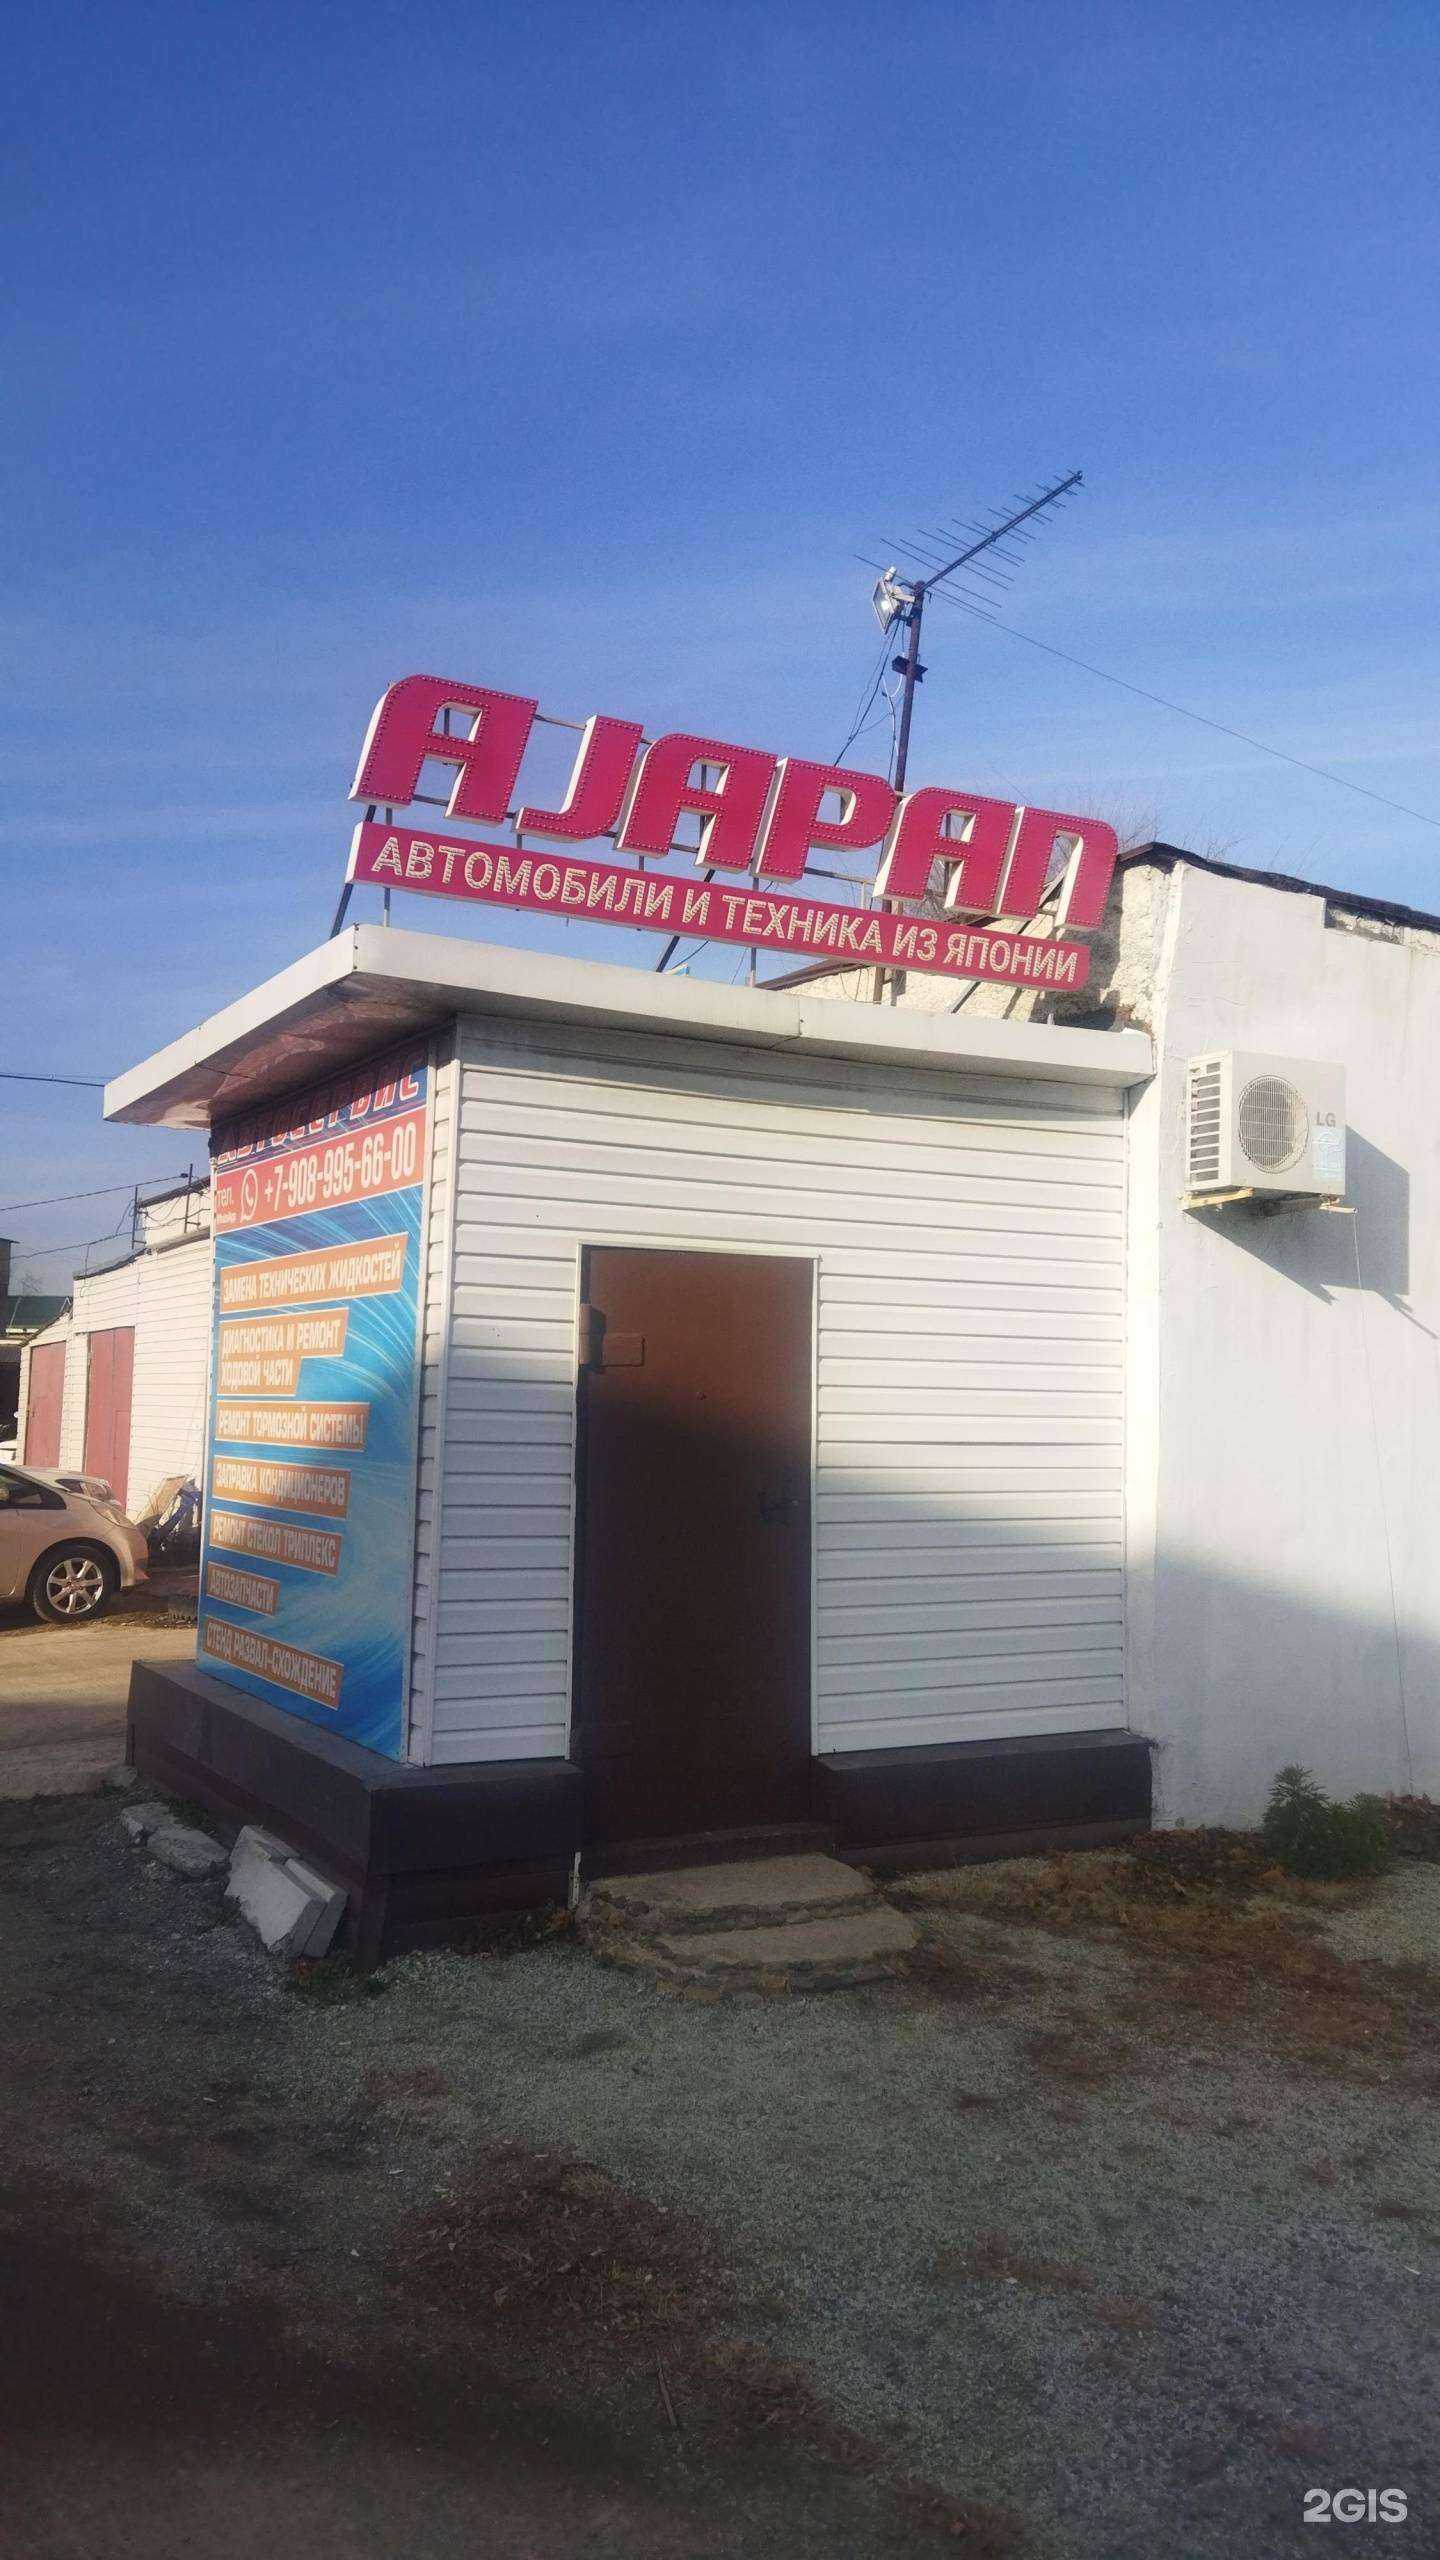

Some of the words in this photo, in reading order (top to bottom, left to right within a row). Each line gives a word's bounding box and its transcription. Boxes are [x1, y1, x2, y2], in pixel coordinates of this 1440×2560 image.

[371, 836, 674, 920] АВТОМОБИЛИ
[682, 888, 711, 926] И
[722, 894, 882, 954] ТЕХНИКА
[892, 923, 938, 961] ИЗ
[943, 932, 1079, 983] ЯПОНИИ
[1316, 1111, 1337, 1128] LG
[264, 1121, 417, 1212] +7-908-995-66-00
[223, 1274, 257, 1304] ЗАМЕНА
[259, 1261, 326, 1299] ТЕХНИЧЕСКИХ
[329, 1241, 401, 1292] ЖИДКОСТЕЙ
[222, 1326, 283, 1359] ДИАГНОСТИКА
[297, 1319, 341, 1350] РЕМОНТ
[221, 1354, 261, 1391] ХОДОВОЙ
[264, 1358, 294, 1386] ЧАСТИ
[218, 1409, 251, 1437] РЕМОНТ
[252, 1406, 307, 1440] ТОРМОЗНОЙ
[310, 1412, 364, 1442] СИСТЕМЫ
[216, 1462, 257, 1492] ЗАПРАВКА
[259, 1468, 345, 1505] КОНДИЦИОНЕРОВ
[213, 1515, 246, 1546] РЕМОНТ
[247, 1523, 281, 1554] СТЕКОЛ
[283, 1529, 337, 1567] ТРИПЛЕКС
[209, 1568, 274, 1611] АВТОЗАПЧАСТИ
[206, 1622, 233, 1660] СТЕНД
